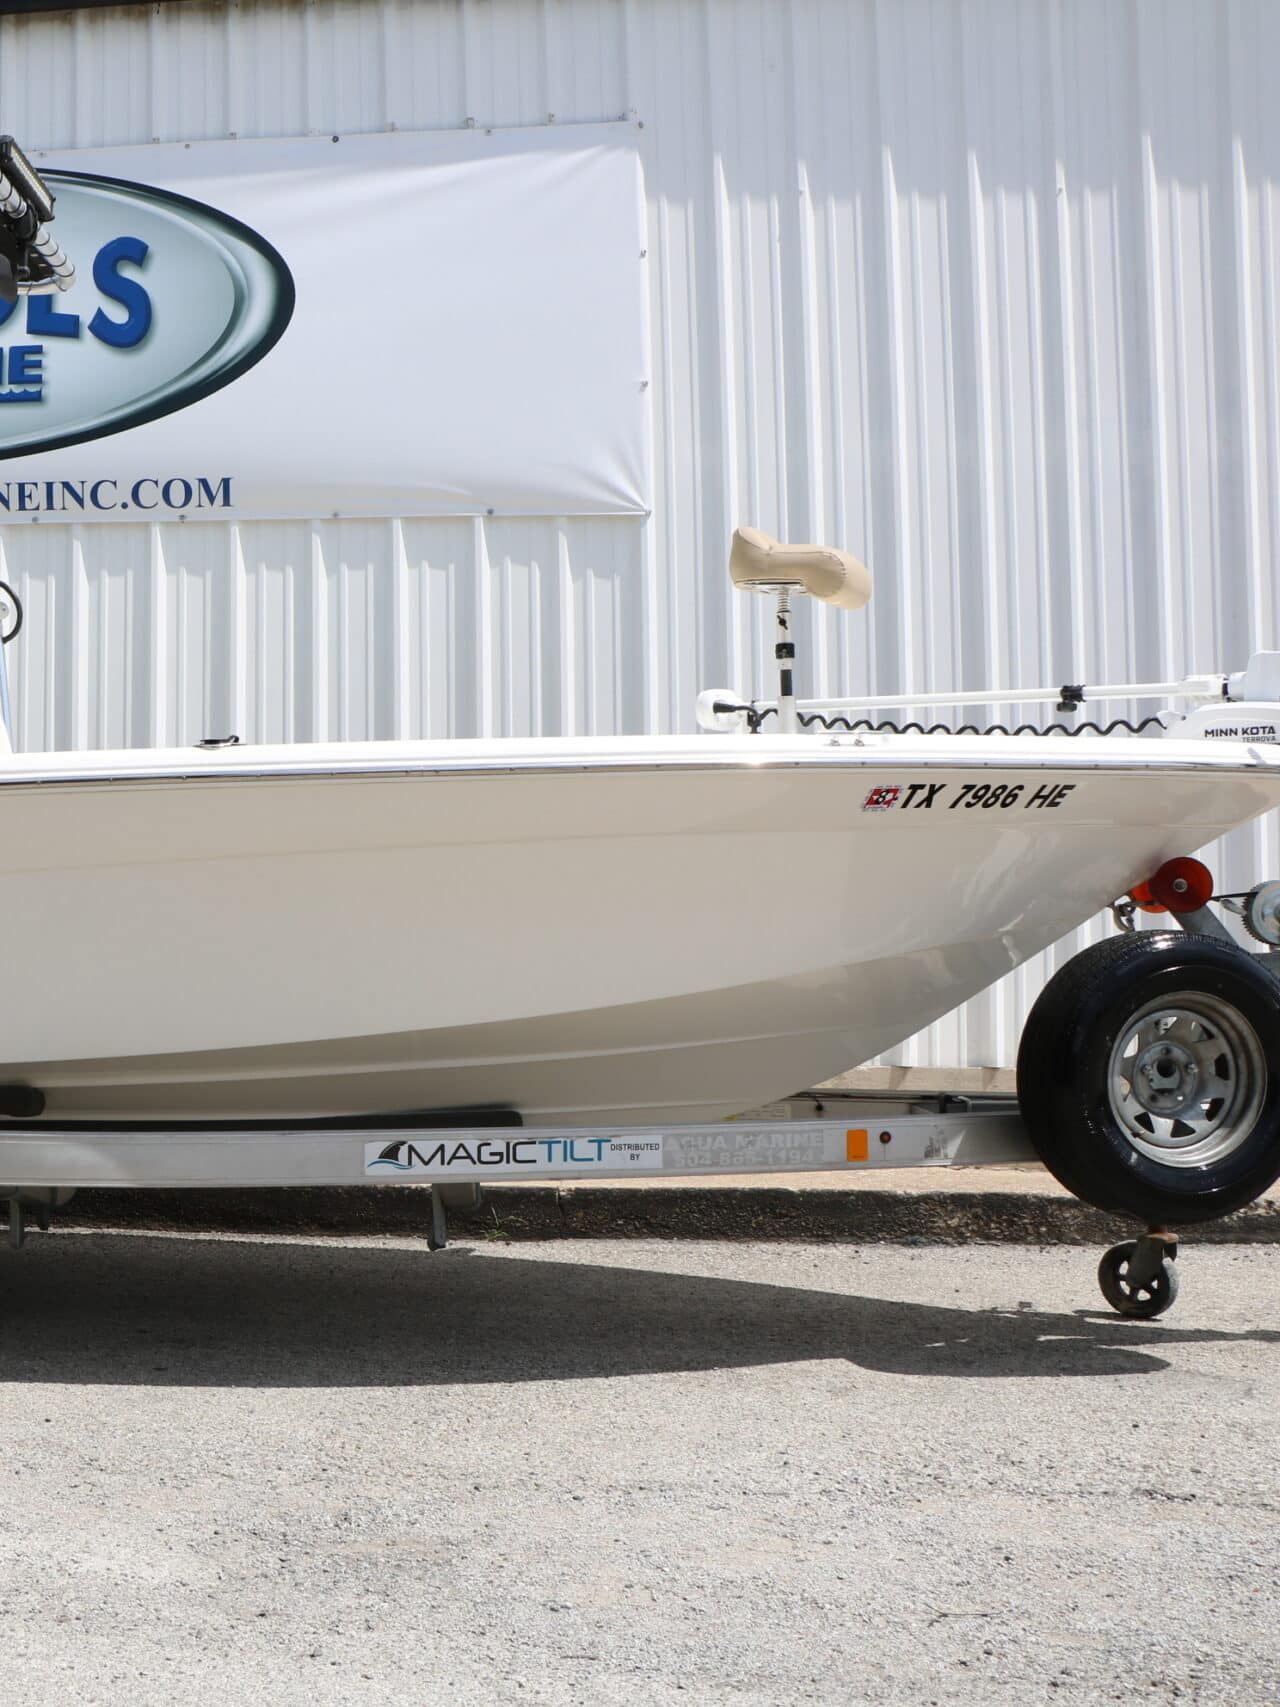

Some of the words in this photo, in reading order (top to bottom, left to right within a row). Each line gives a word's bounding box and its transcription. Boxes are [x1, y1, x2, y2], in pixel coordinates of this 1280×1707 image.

[1204, 728, 1238, 738] MINN
[1241, 726, 1276, 736] KOTA
[900, 784, 947, 808] TX
[948, 784, 1024, 808] 7986
[1024, 784, 1077, 808] HE
[408, 1138, 612, 1167] MAGICTILT
[610, 1143, 660, 1152] DISTRIBUTED
[629, 1153, 641, 1162] BY
